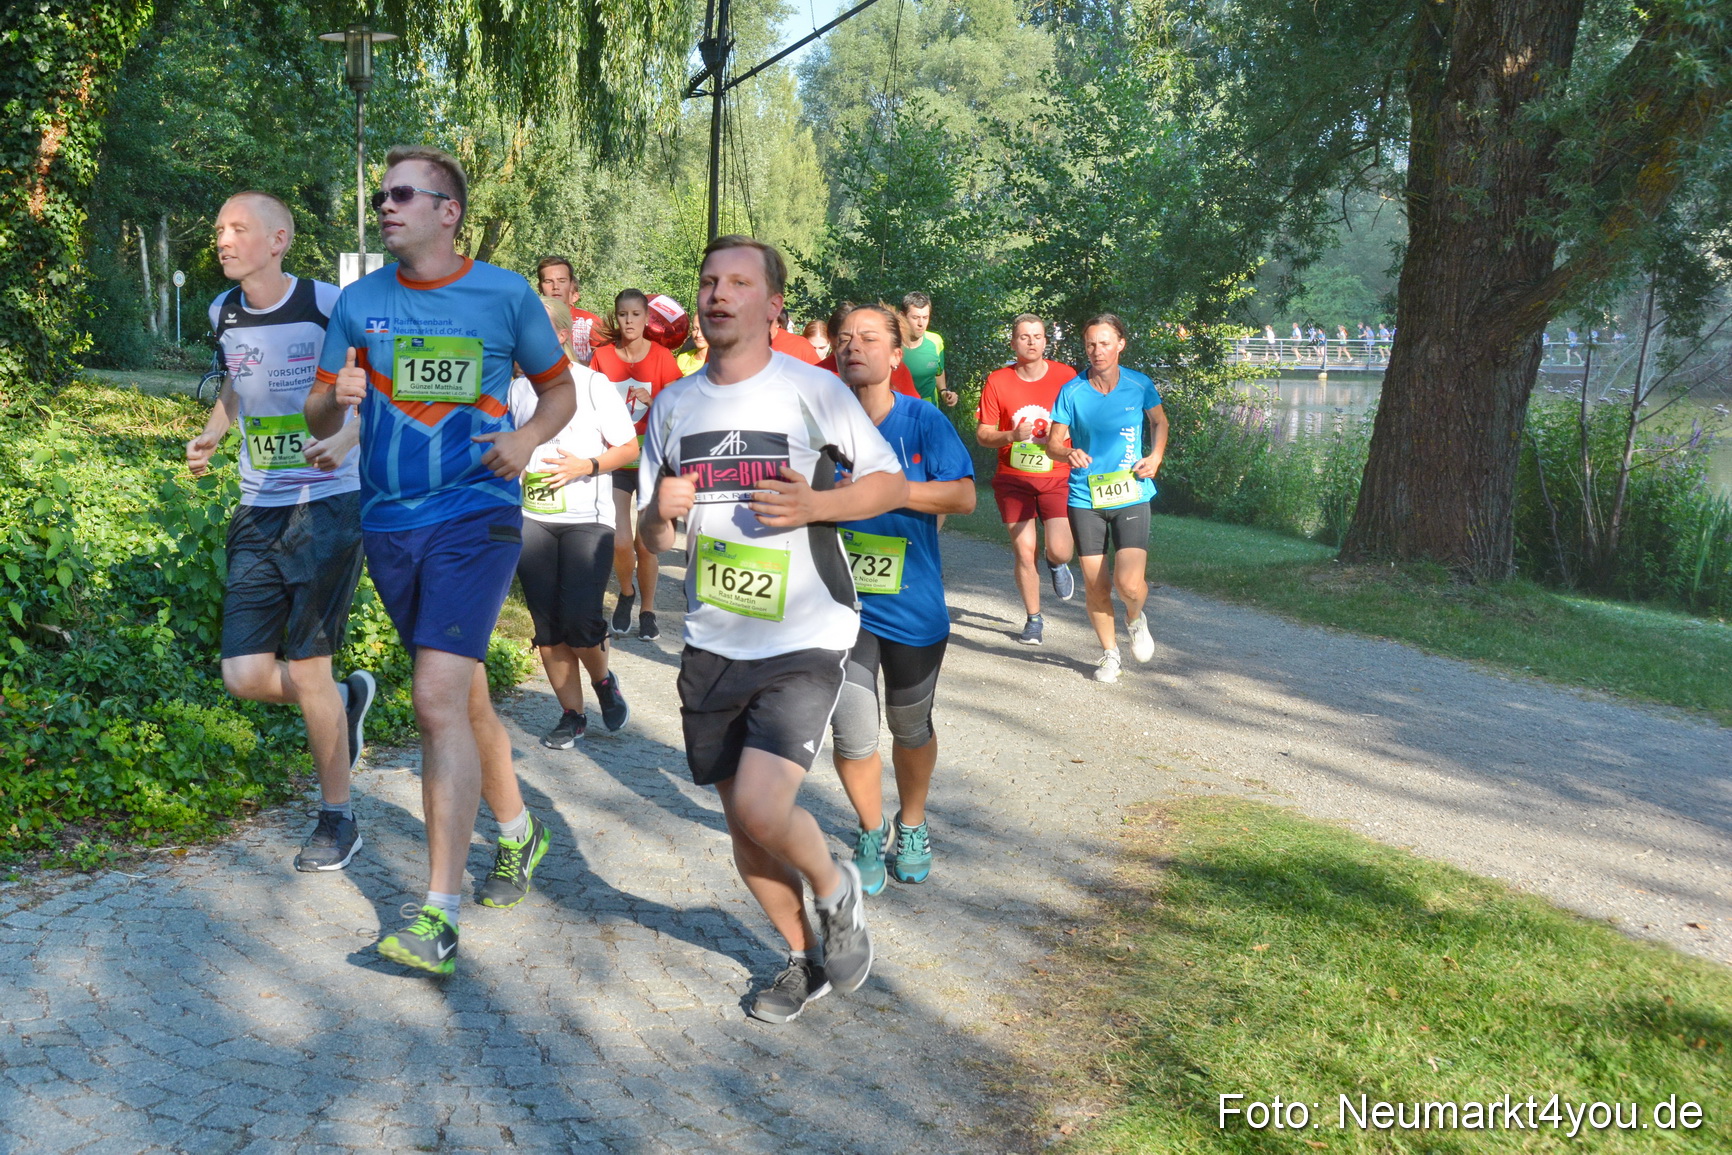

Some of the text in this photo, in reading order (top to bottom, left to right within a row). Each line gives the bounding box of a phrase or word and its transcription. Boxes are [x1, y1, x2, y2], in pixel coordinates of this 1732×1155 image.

[393, 317, 453, 326] Raiffeisenbank
[393, 327, 433, 335] Neumarkt
[465, 329, 478, 337] eG
[268, 365, 315, 377] VORSICHT!
[405, 359, 470, 383] 1587
[434, 383, 463, 391] Matthias
[253, 434, 302, 454] 1475
[1020, 453, 1043, 466] 772
[522, 484, 555, 501] 1821
[1096, 481, 1130, 498] 1401
[849, 552, 892, 577] 732
[707, 563, 773, 599] 1622
[718, 590, 756, 605] Rast Martin
